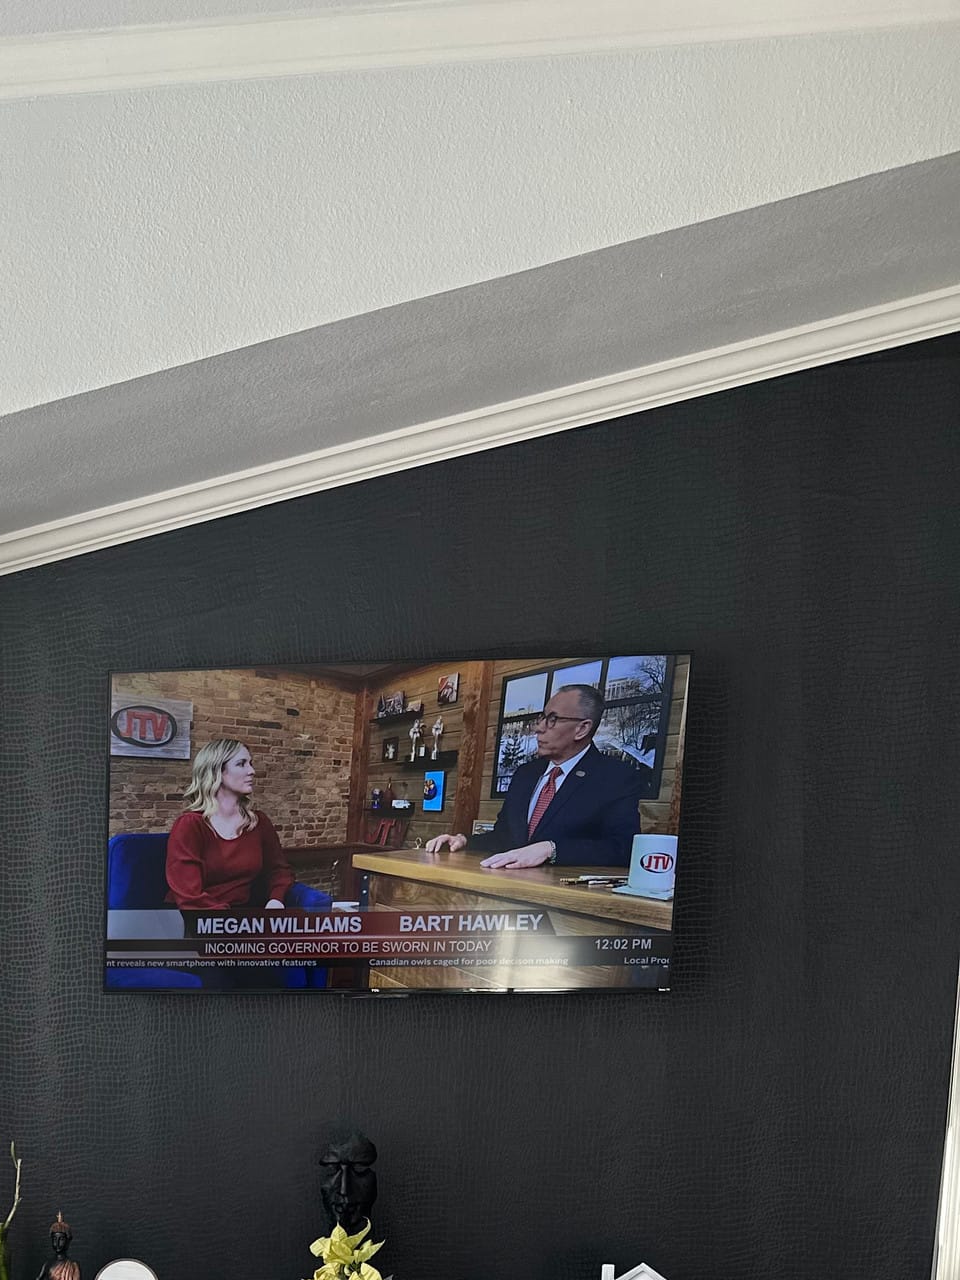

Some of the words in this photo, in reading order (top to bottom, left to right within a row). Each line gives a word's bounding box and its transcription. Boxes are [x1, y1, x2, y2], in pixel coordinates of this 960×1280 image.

[644, 855, 670, 870] JTV
[197, 918, 264, 934] MEGAN
[270, 917, 362, 933] WILLIAMS
[399, 915, 453, 931] BART
[458, 914, 544, 931] HAWLEY
[205, 942, 266, 954] INCOMING
[268, 942, 339, 954] GOVERNOR
[342, 942, 359, 953] TO
[362, 942, 379, 953] BE
[382, 941, 429, 953] SWORN
[433, 941, 446, 952] IN
[449, 941, 492, 952] TODAY
[595, 938, 628, 950] 12:02
[632, 938, 652, 950] PM
[166, 960, 216, 968] smartphone
[369, 958, 409, 966] Canadian
[411, 958, 431, 966] owls
[433, 958, 459, 967] caged
[536, 957, 569, 967] making
